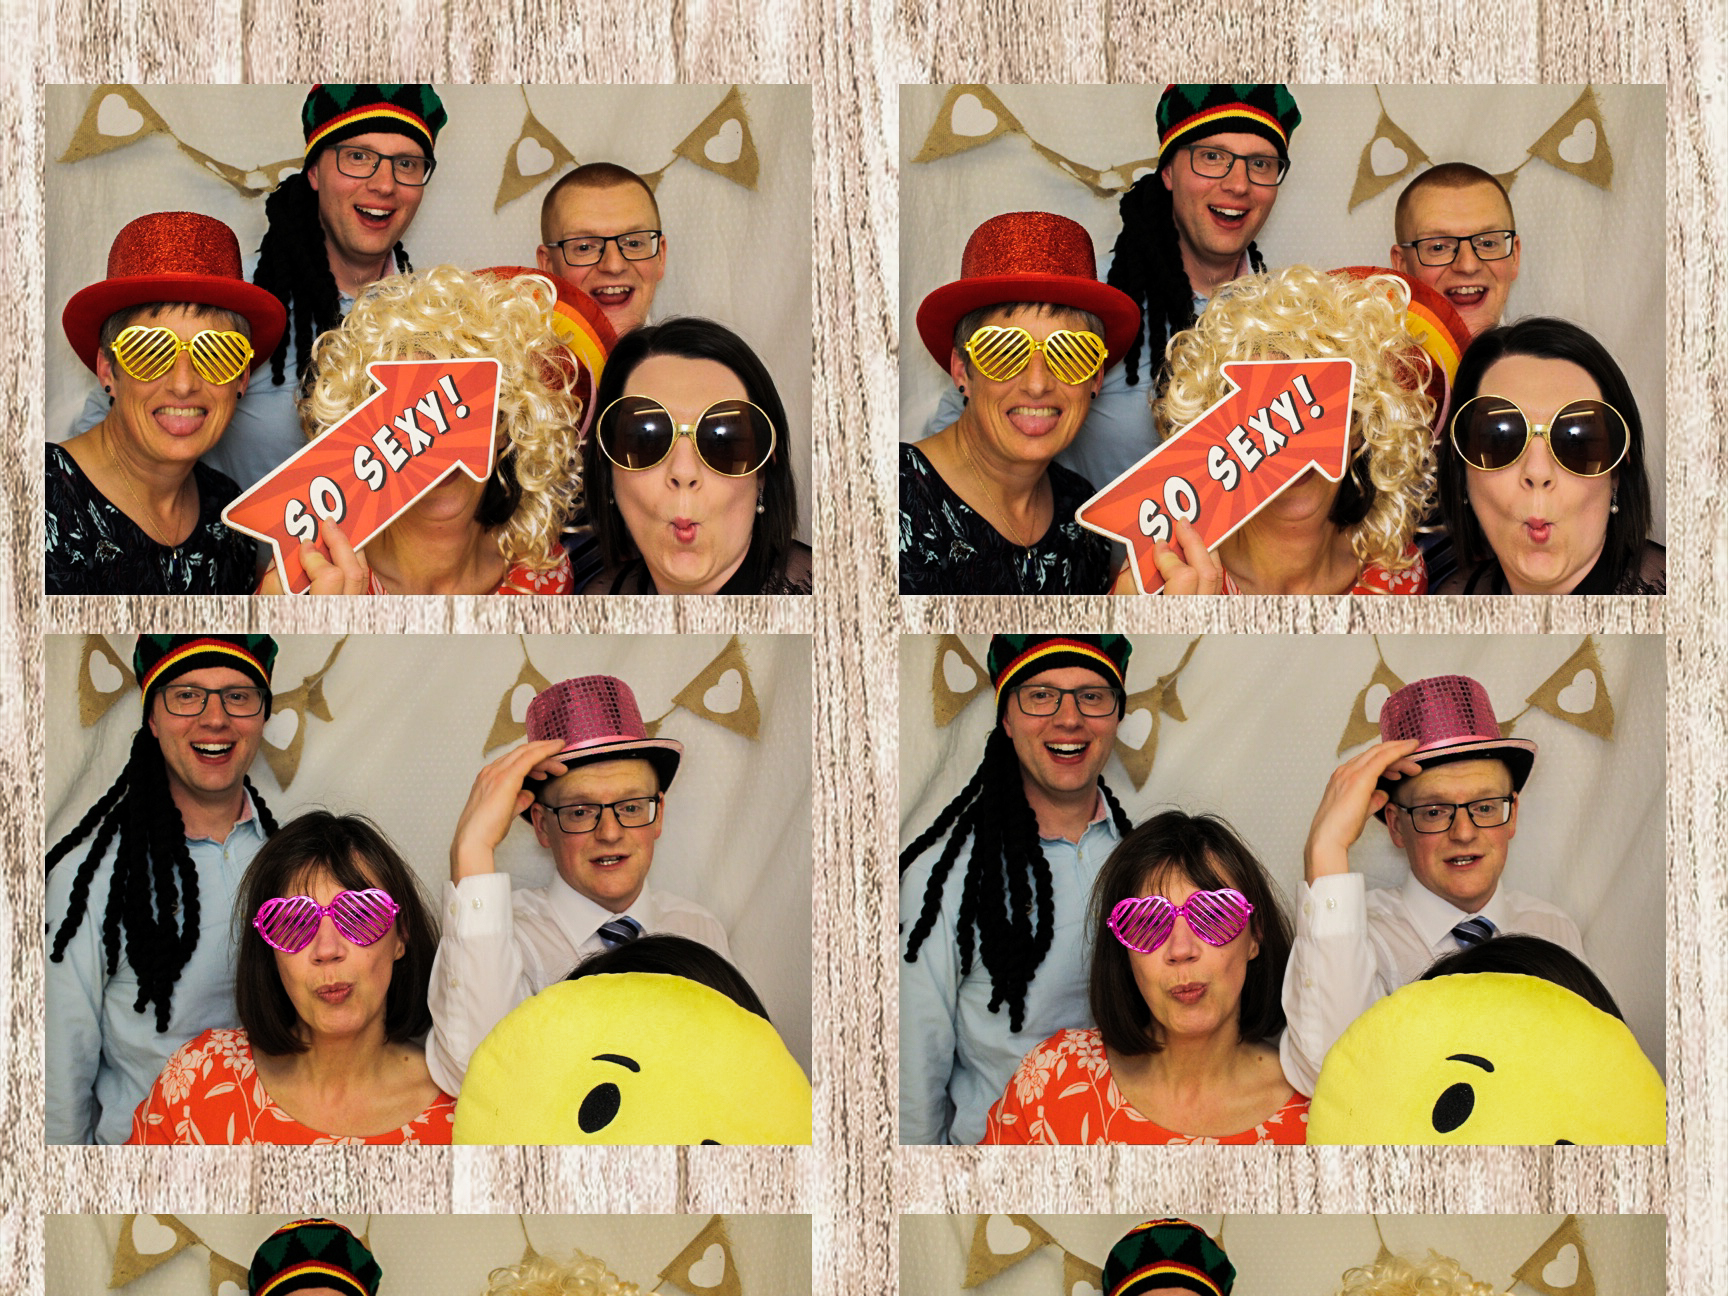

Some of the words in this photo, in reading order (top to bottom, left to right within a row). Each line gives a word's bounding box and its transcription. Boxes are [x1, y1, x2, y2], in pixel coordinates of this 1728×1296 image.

[284, 476, 347, 543] SO
[354, 374, 471, 491] SEXY!
[1138, 476, 1201, 543] SO
[1208, 374, 1325, 491] SEXY!
